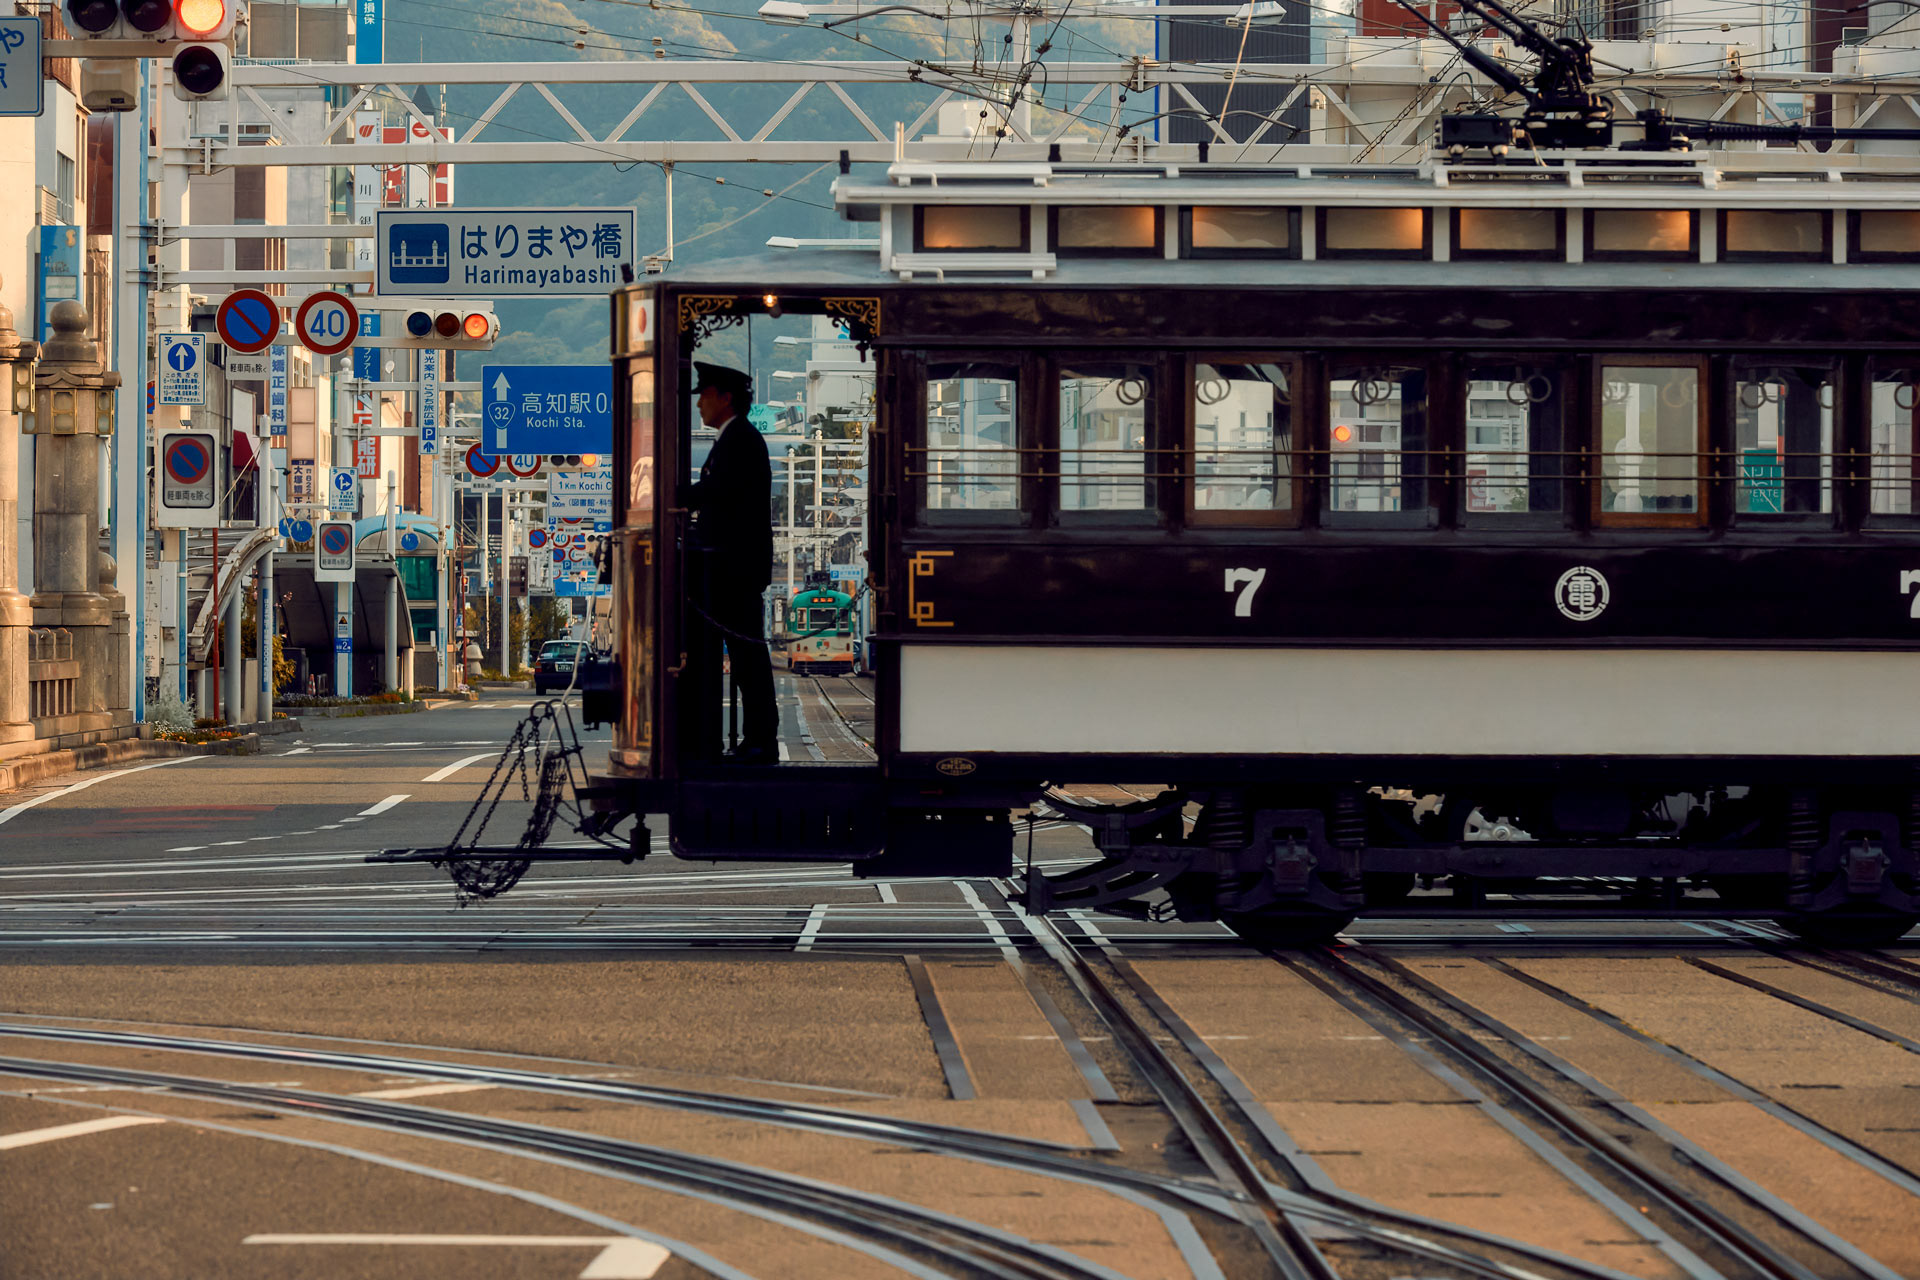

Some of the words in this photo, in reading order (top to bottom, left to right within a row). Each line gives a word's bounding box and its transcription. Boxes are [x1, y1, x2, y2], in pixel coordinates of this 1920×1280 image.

[461, 223, 622, 259] はりまや橋
[465, 265, 616, 288] Harimayabashi
[310, 309, 344, 337] 40
[230, 363, 267, 373] 軽車両を除く
[272, 344, 285, 422] 塚矯正歯科
[522, 392, 591, 413] 高知駅
[494, 407, 509, 420] 32
[526, 417, 558, 428] Kochi
[563, 417, 586, 428] Sta.
[167, 490, 210, 501] 軽車両を除く
[579, 482, 603, 490] Kochi
[1225, 567, 1266, 617] 7
